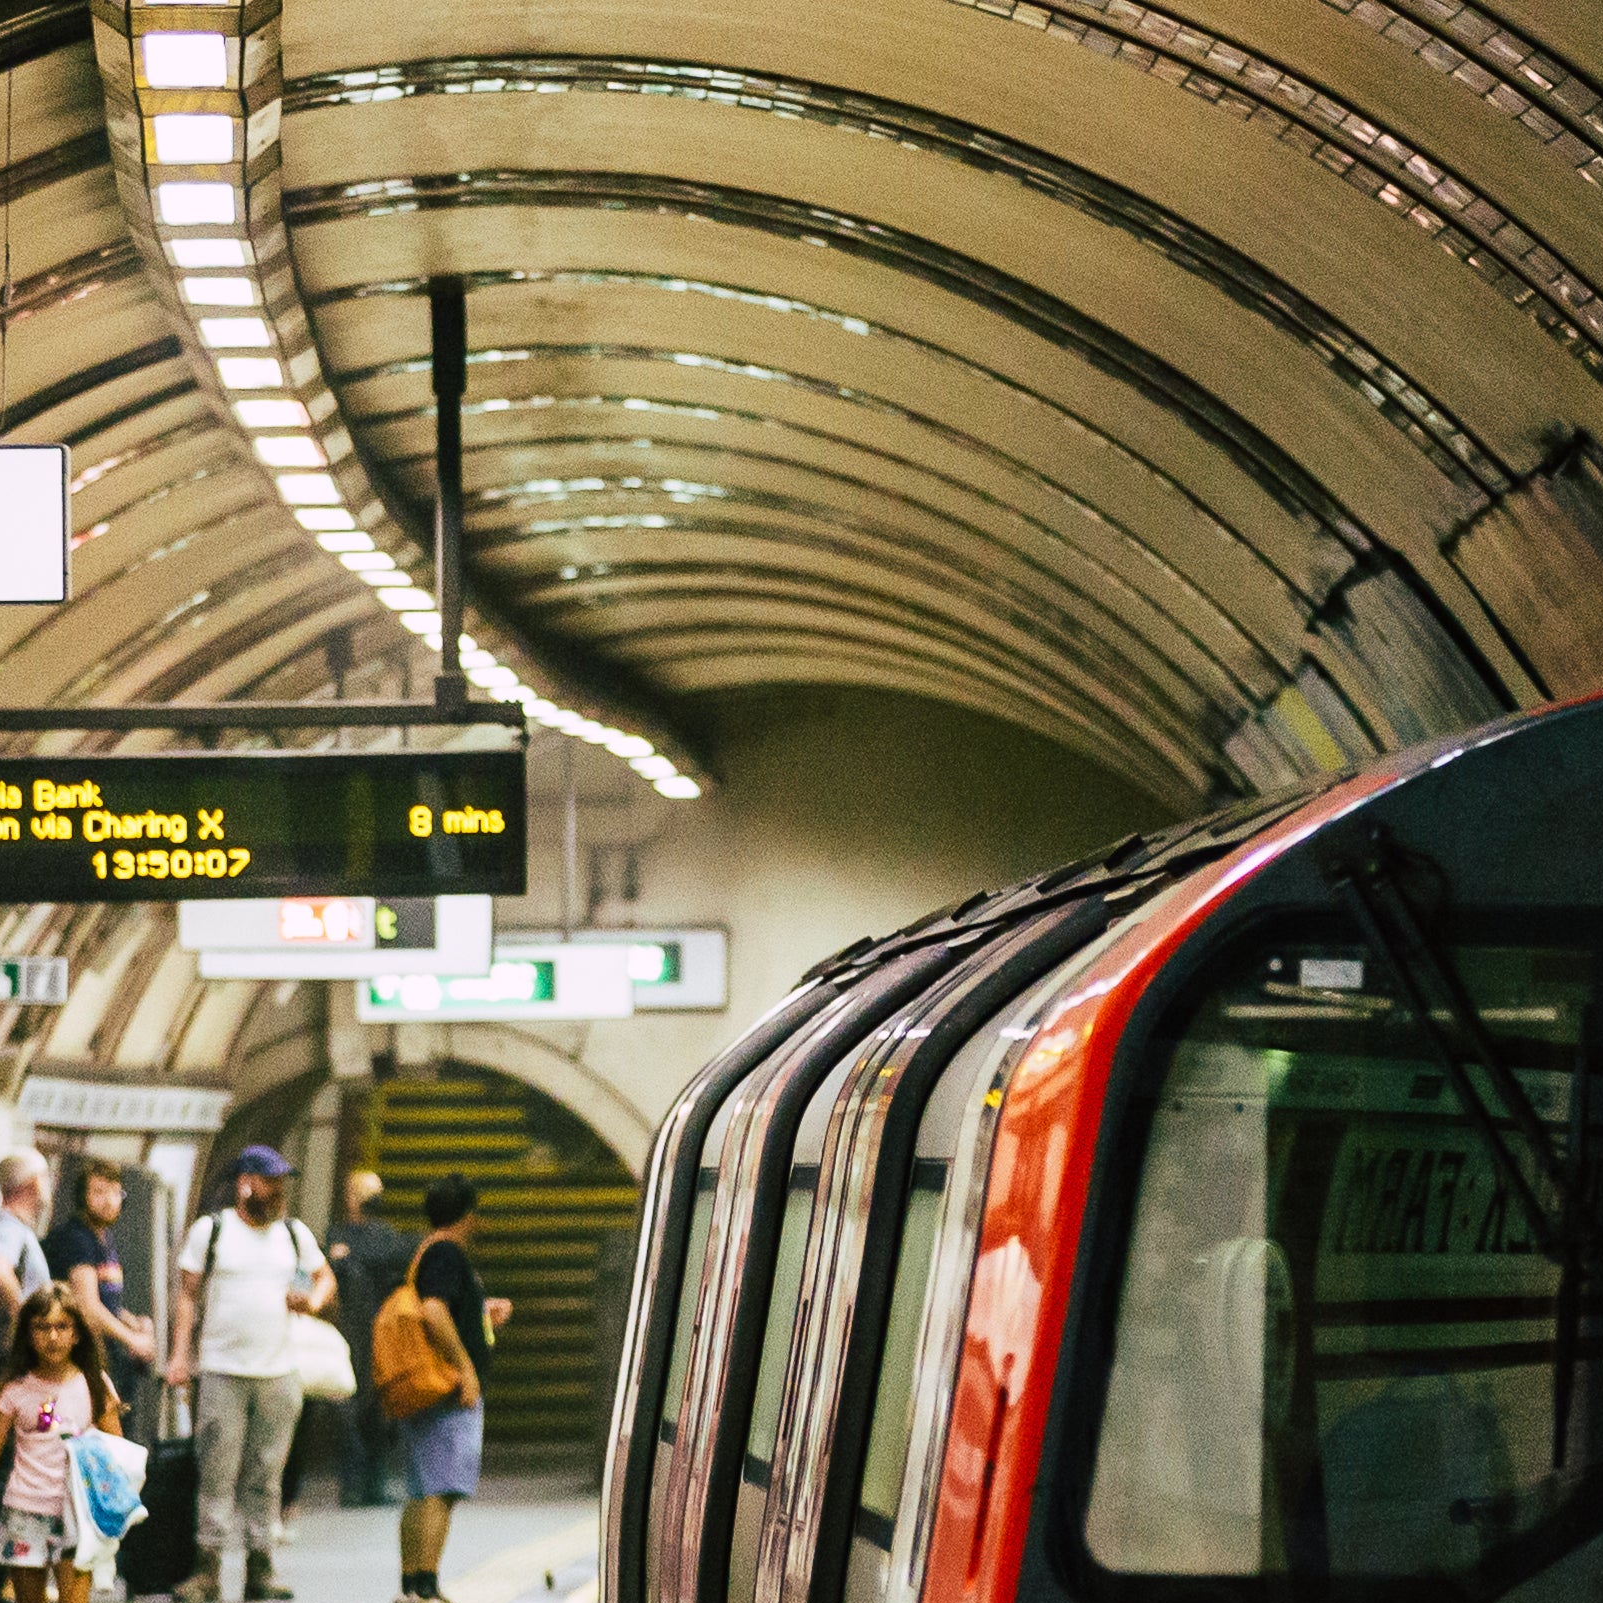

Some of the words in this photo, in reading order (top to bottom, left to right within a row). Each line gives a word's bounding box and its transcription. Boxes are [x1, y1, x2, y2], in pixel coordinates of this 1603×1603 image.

[33, 780, 103, 810] Bank
[31, 811, 72, 840] via
[83, 809, 187, 843] Charing
[198, 809, 224, 840] X
[408, 805, 433, 838] 8
[443, 806, 505, 834] mins
[92, 848, 251, 880] 13:50:07
